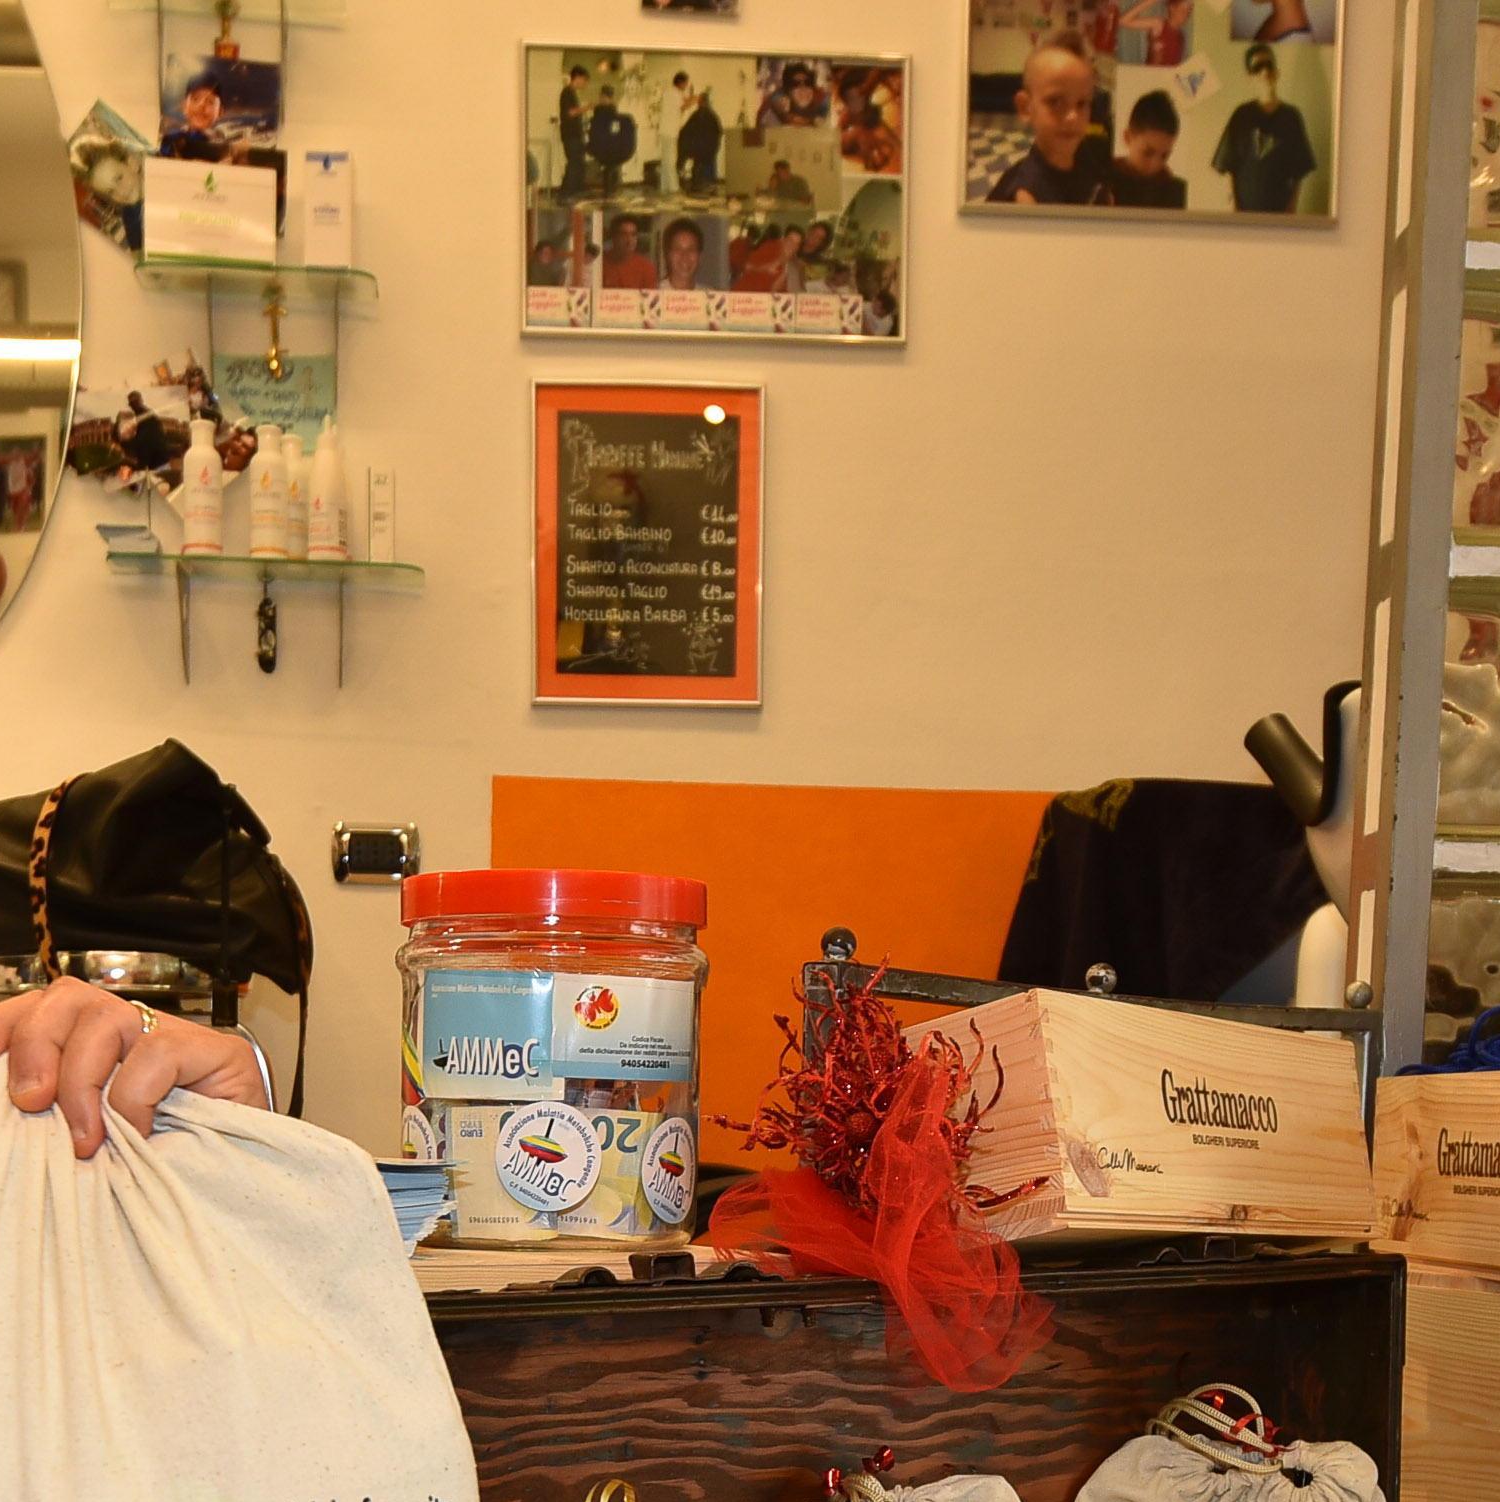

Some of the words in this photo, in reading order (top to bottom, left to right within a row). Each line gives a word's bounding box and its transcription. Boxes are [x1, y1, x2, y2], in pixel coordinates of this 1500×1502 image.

[567, 498, 612, 518] TAGLIO
[567, 523, 612, 541] TAGLIO
[627, 581, 668, 599] TAGLIO
[644, 605, 687, 622] BARBA
[445, 1036, 540, 1078] AMMeC
[1160, 1068, 1279, 1134] Grattamacco
